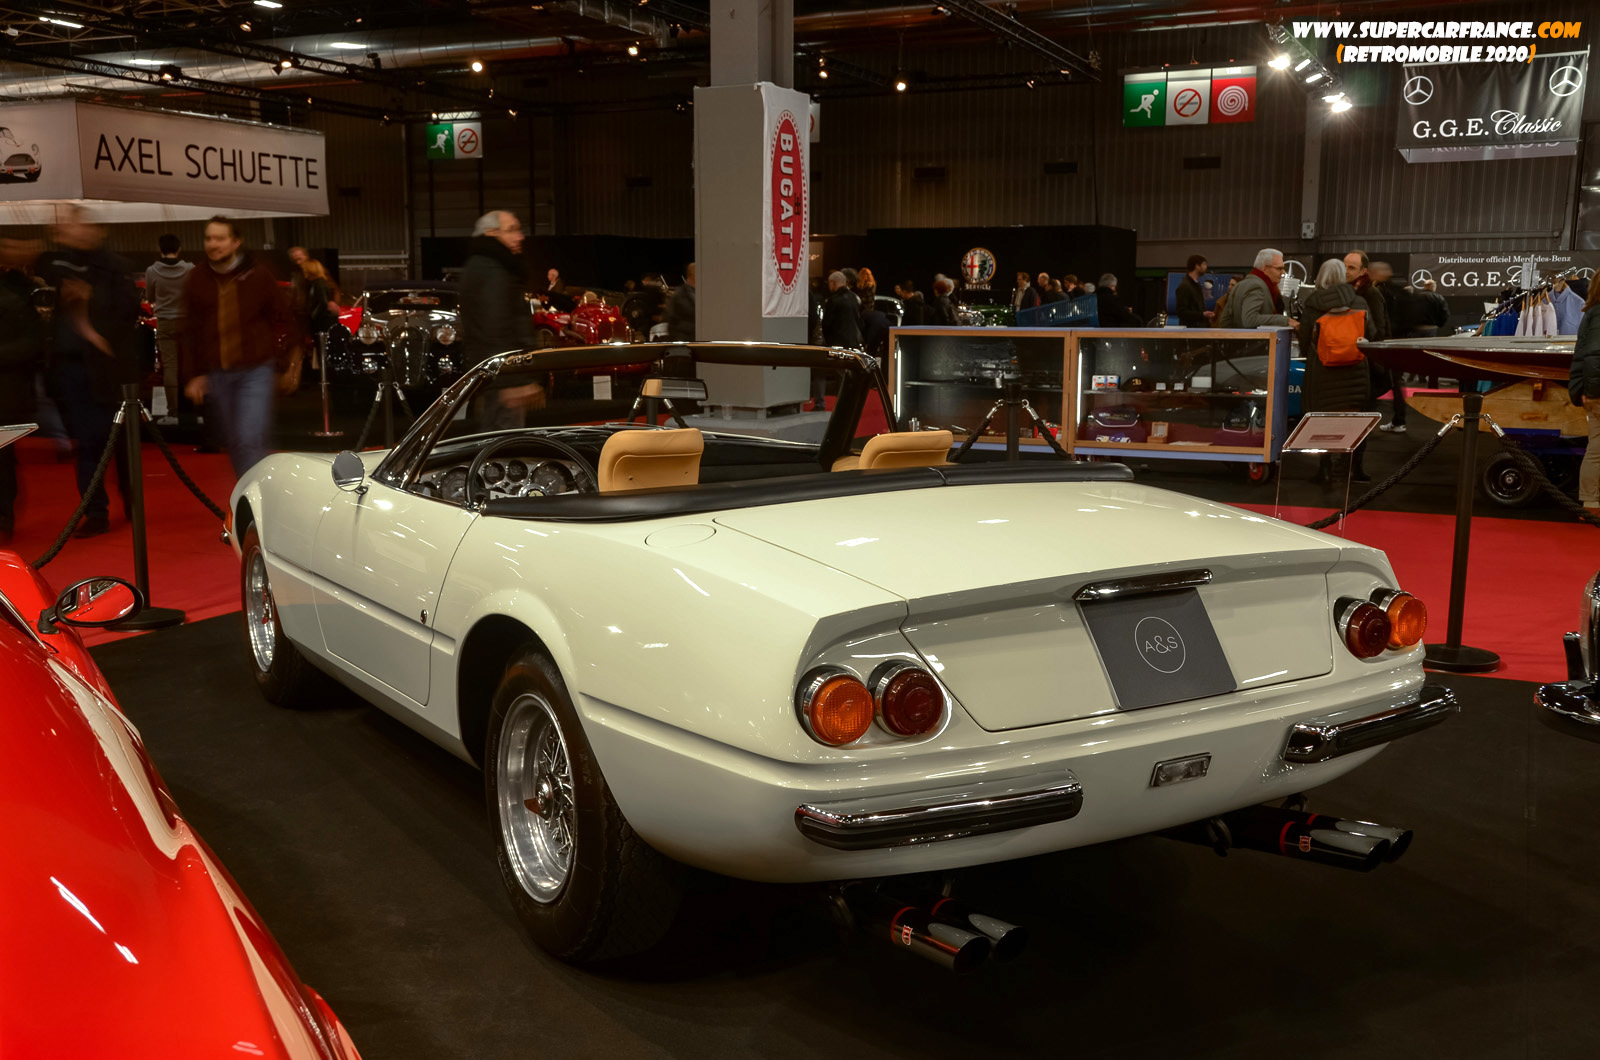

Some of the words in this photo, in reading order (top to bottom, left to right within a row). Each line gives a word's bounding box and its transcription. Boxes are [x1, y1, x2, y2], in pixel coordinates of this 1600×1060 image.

[1412, 117, 1489, 139] G.G.E.
[1490, 109, 1562, 136] Classic
[94, 133, 173, 176] AXEL
[184, 143, 319, 190] SCHUETTE
[780, 132, 794, 271] BUGATTI
[1438, 256, 1485, 264] Distributeur
[1485, 255, 1511, 263] officiel
[1512, 254, 1572, 264] Mercdes-Benz
[1440, 271, 1506, 287] G.G.E.
[1145, 635, 1179, 654] A&S
